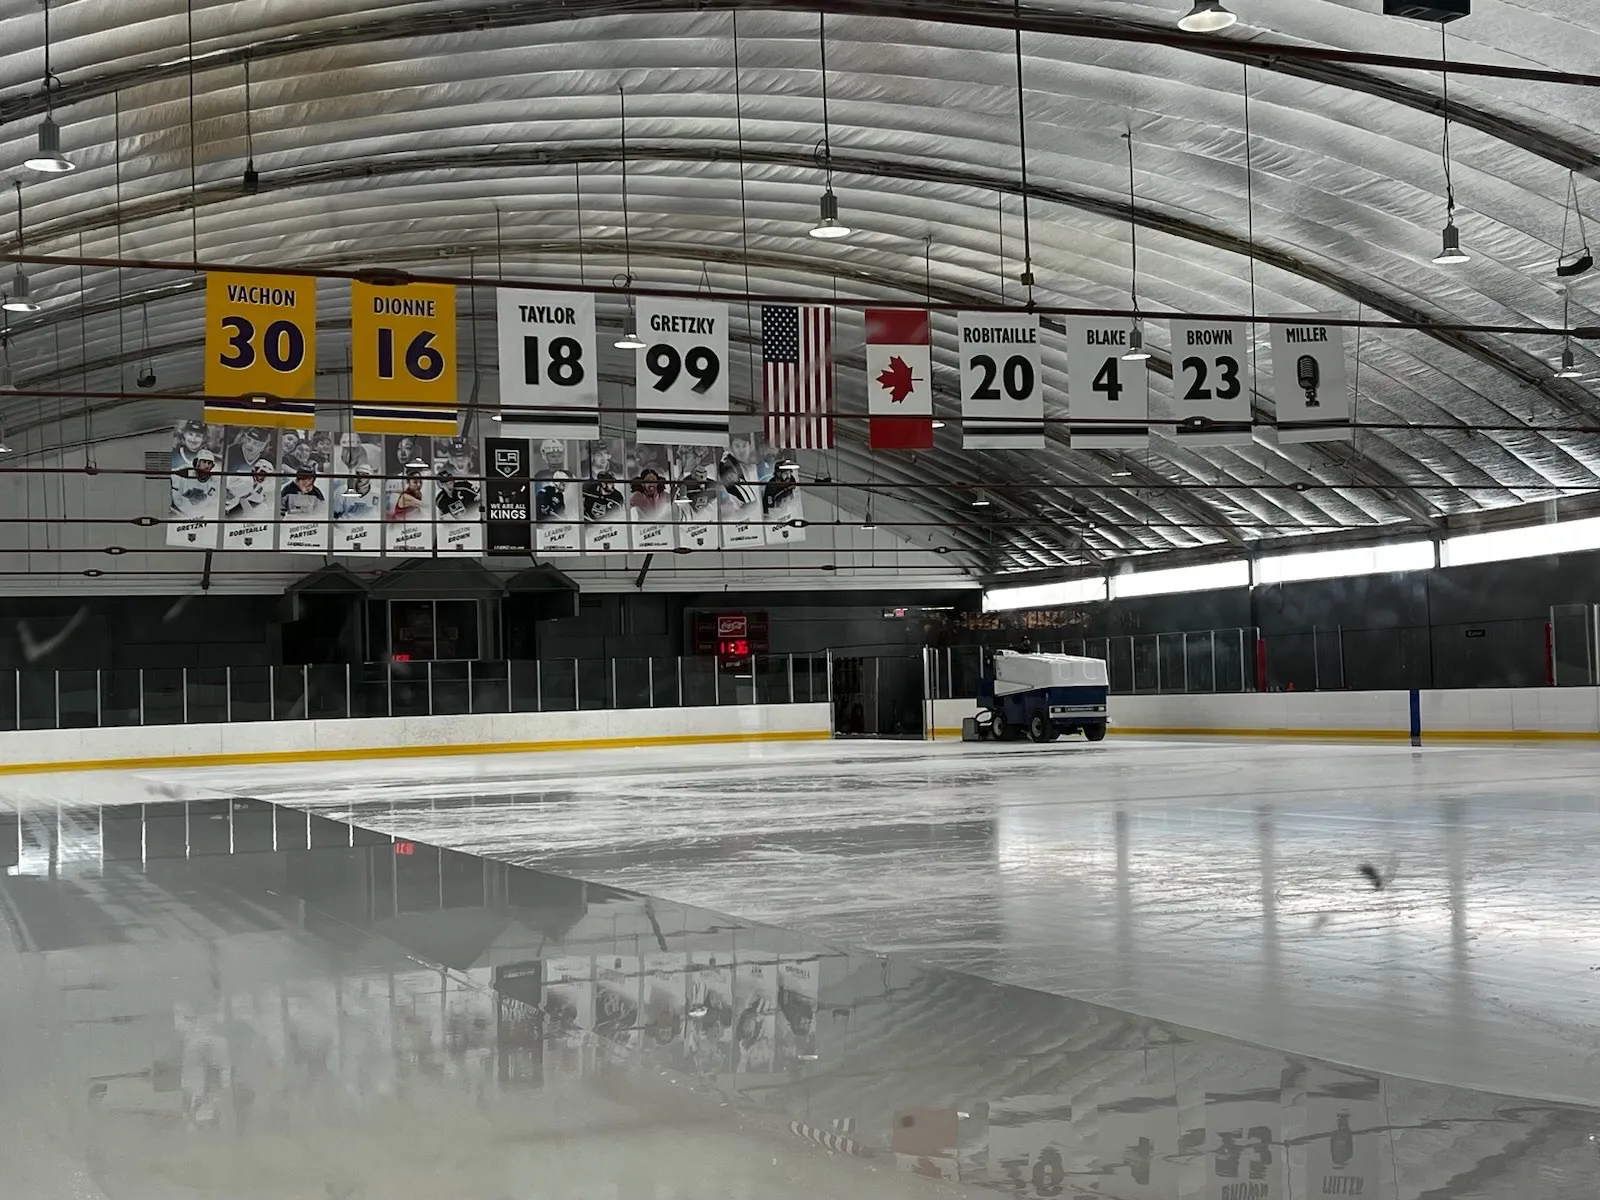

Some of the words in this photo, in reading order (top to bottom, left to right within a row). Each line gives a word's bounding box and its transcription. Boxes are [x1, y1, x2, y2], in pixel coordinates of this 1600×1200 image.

[227, 284, 297, 308] VACHON
[373, 296, 436, 318] DIONNE
[518, 305, 577, 325] TAYLOR
[650, 314, 716, 335] GRETZKY
[963, 327, 1037, 344] ROBITAILLE
[1086, 329, 1126, 346] BLAKE
[1186, 329, 1233, 346] BROWN
[1286, 327, 1328, 343] MILLER
[219, 315, 306, 374] 30
[377, 327, 446, 383] 16
[523, 335, 585, 387] 18
[645, 343, 720, 395] 99
[969, 354, 1035, 401] 20
[1182, 355, 1241, 400] 23
[1092, 357, 1123, 401] 4
[497, 452, 517, 462] LA
[490, 509, 527, 519] KINGS
[176, 522, 208, 532] GRETZKY
[229, 525, 268, 537] ROBITAILLE
[289, 529, 317, 540] PARTIES
[643, 530, 662, 540] SKATE
[346, 532, 367, 541] BLAKE
[448, 533, 471, 543] BROWN
[550, 533, 566, 542] PLAY
